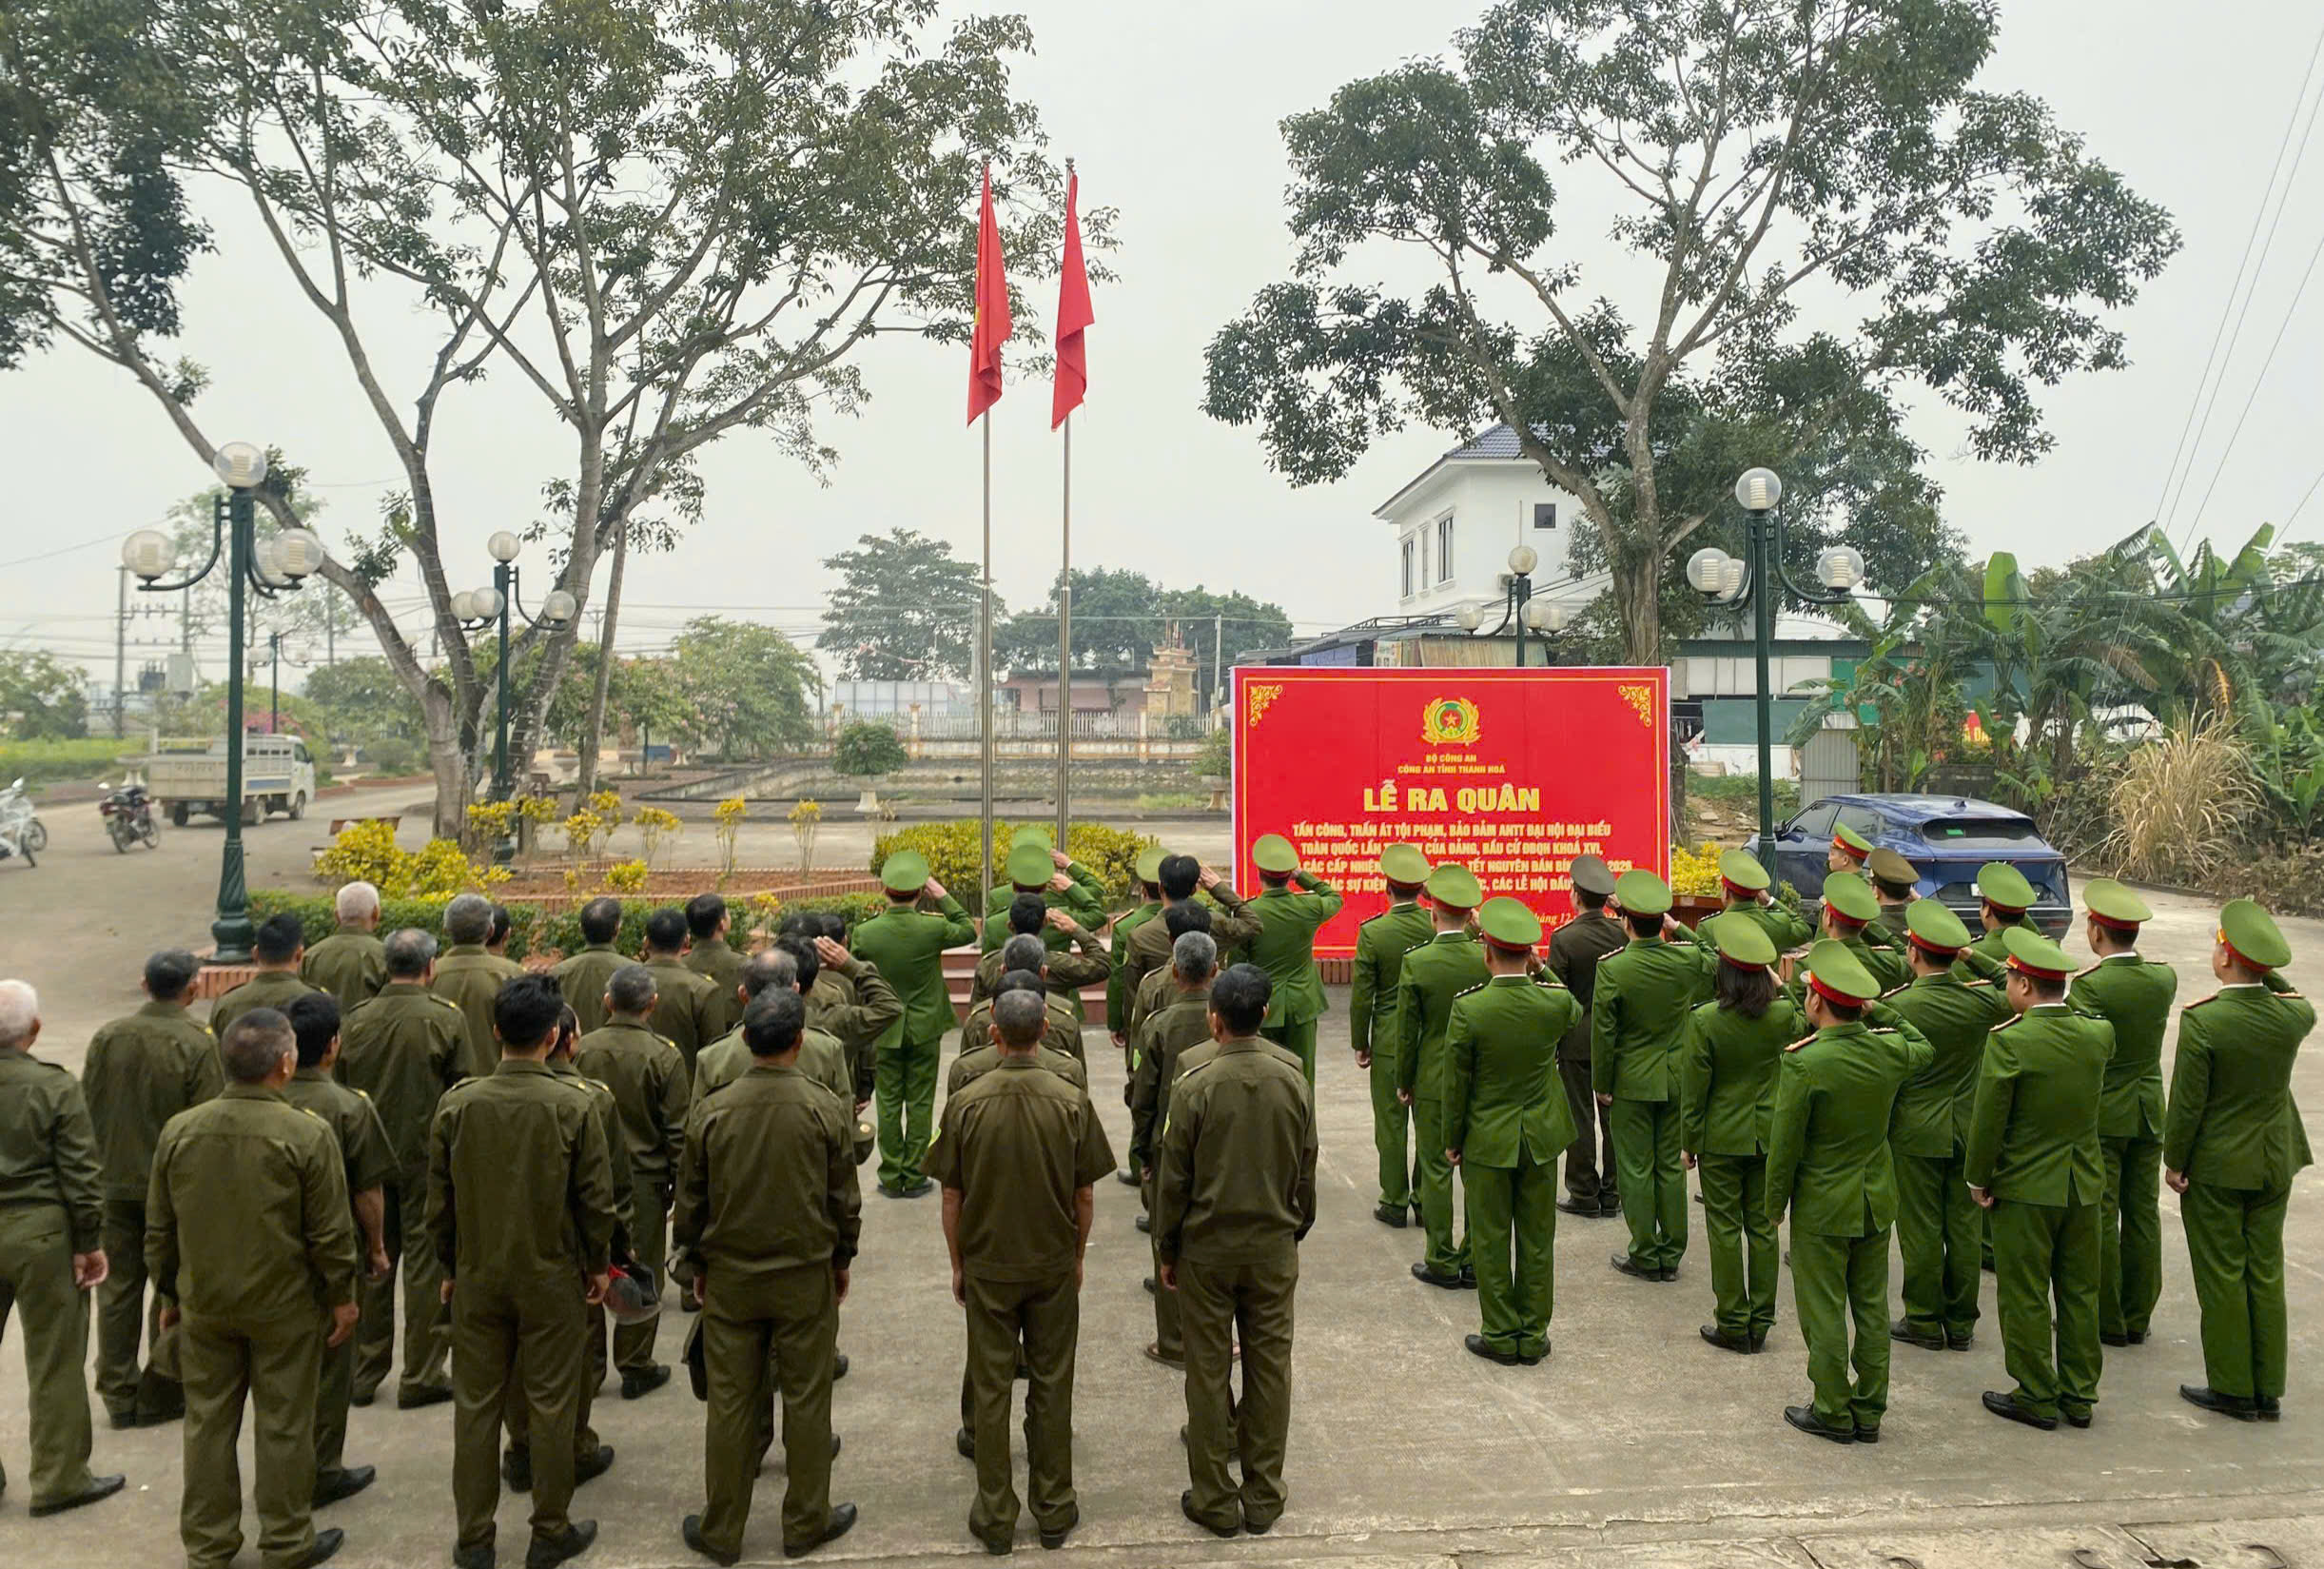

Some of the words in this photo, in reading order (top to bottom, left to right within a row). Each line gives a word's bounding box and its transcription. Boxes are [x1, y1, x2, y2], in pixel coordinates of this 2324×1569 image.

[1439, 753, 1463, 763] CÔNG
[1465, 754, 1477, 763] AN
[1397, 763, 1421, 774] CÔNG
[1423, 765, 1435, 774] AN
[1459, 765, 1486, 774] THANH
[1364, 778, 1398, 812] LỄ
[1407, 788, 1449, 812] RA
[1457, 782, 1540, 814] QUÂN
[1293, 820, 1314, 836] TẤN
[1316, 822, 1347, 838] CÔNG,
[1350, 820, 1377, 836] TRẤN
[1395, 821, 1411, 839] TỘI
[1413, 824, 1447, 839] PHẠM,
[1449, 819, 1471, 836] BẢO
[1499, 824, 1525, 836] ANTT
[1527, 824, 1546, 839] ĐẠI
[1547, 821, 1566, 839] HỘI
[1567, 824, 1585, 839] ĐẠI
[1587, 819, 1611, 836] BIỂU
[1300, 839, 1329, 855] TOÀN
[1331, 838, 1359, 856] QUỐC
[1425, 837, 1447, 855] CỦA
[1583, 842, 1604, 856] XVI,
[1303, 858, 1325, 873] CÁC
[1326, 857, 1348, 873] CẤP
[1467, 856, 1485, 873] TẾT
[1487, 858, 1530, 873] NGUYÊN
[1531, 858, 1553, 873] ĐÁN
[1346, 877, 1363, 894] SỰ
[1362, 875, 1387, 893] KIỆN
[1493, 876, 1514, 892] CÁC
[1530, 875, 1548, 893] HỘI
